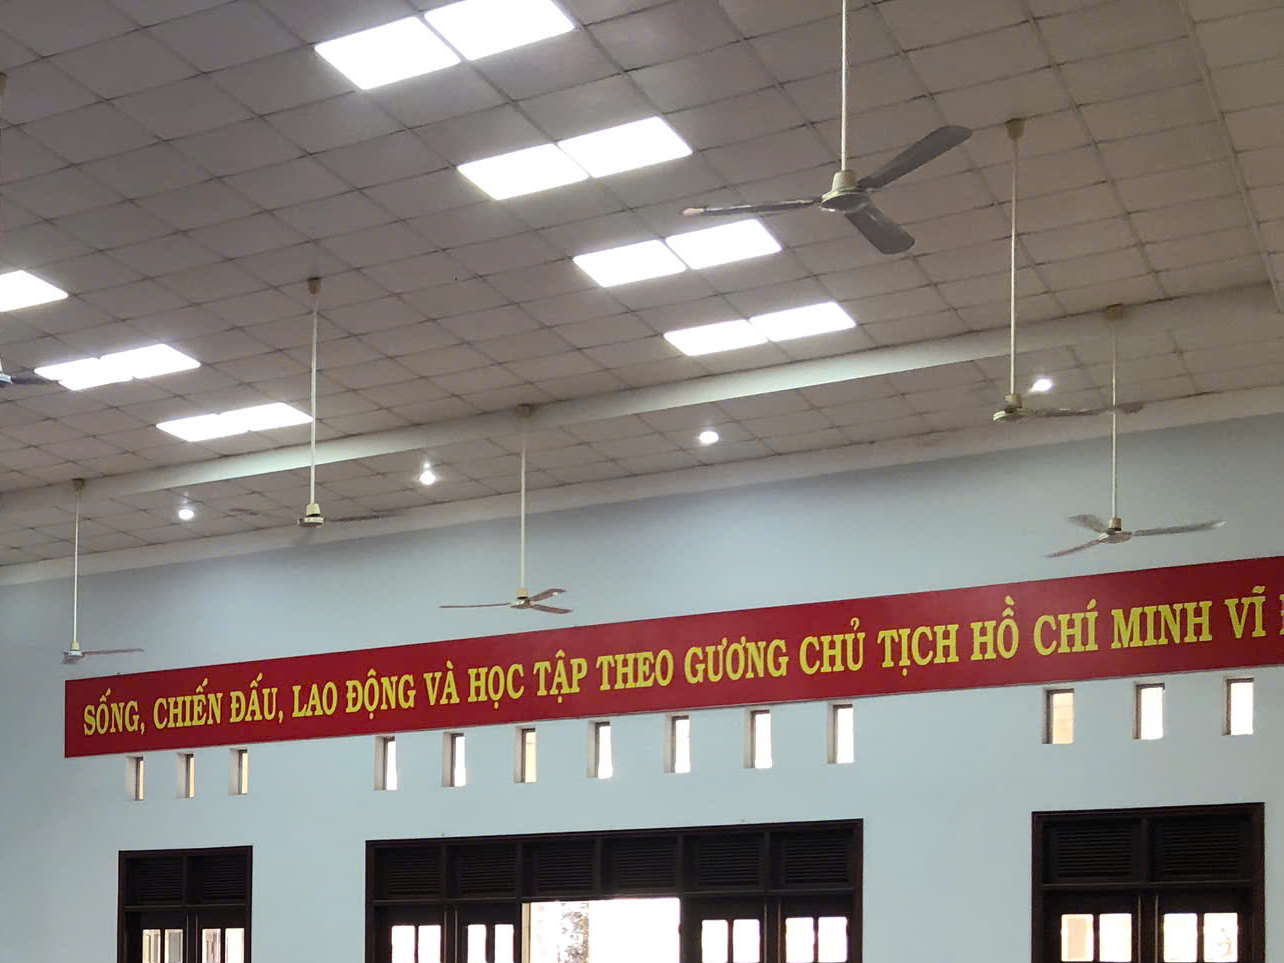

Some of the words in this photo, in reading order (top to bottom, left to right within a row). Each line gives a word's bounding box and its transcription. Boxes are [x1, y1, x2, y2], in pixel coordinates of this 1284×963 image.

[83, 686, 146, 737] SỐNG,
[153, 672, 222, 729] CHIẾN
[229, 672, 283, 725] ĐẤU,
[292, 680, 337, 719] LAO
[345, 668, 416, 720] ĐỘNG
[422, 659, 460, 706] VÀ
[467, 664, 524, 711] HỌC
[533, 648, 588, 704] TẬP
[596, 649, 674, 692] THEO
[684, 637, 789, 684] GƯƠNG
[799, 617, 866, 674] CHỦ
[877, 623, 959, 677] TỊCH
[971, 594, 1019, 662] HỒ
[1033, 598, 1098, 654] CHÍ
[1111, 600, 1213, 650] MINH
[1224, 586, 1267, 638] VĨ
